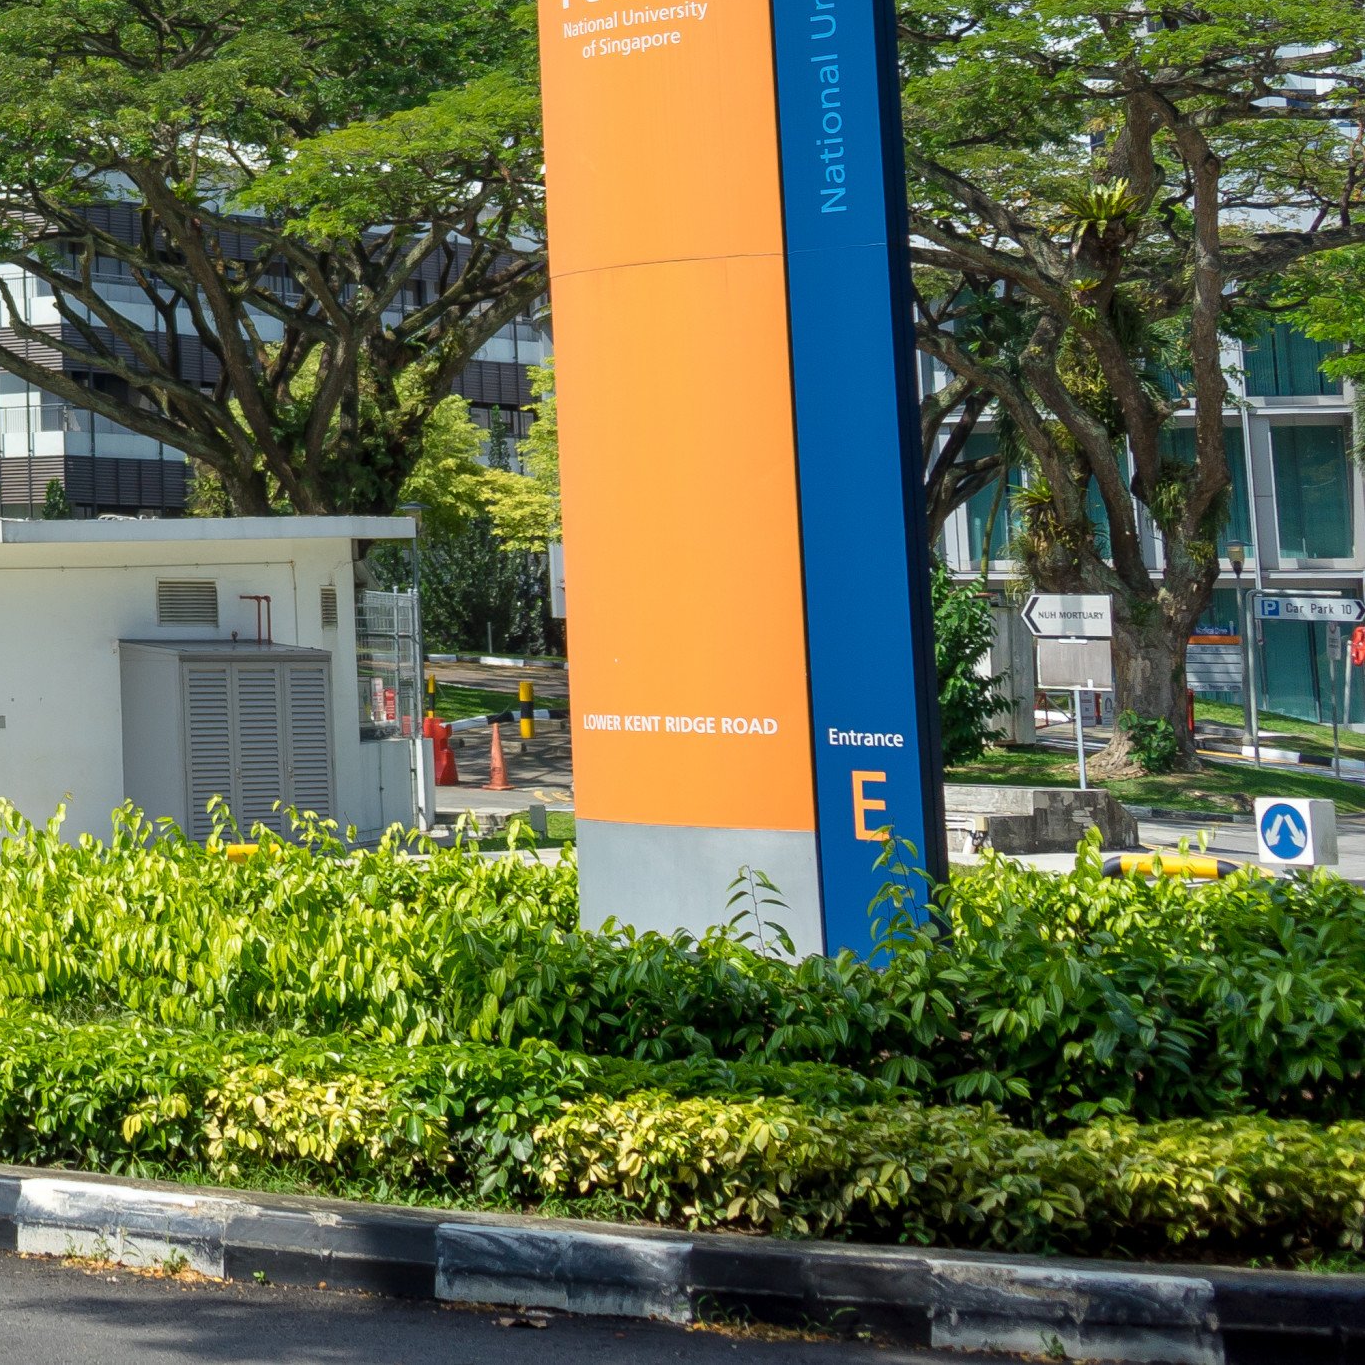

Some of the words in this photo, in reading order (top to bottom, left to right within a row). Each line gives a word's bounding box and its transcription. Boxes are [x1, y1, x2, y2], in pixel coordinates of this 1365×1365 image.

[563, 11, 618, 38] National
[622, 0, 708, 26] University
[582, 39, 597, 58] of
[599, 30, 681, 55] Singapore
[810, 54, 847, 214] National
[1038, 611, 1057, 619] NUH
[1059, 612, 1104, 620] MORTUARY
[1285, 603, 1304, 613] Car
[1310, 604, 1334, 614] Park
[1341, 605, 1352, 615] 10
[583, 714, 621, 731] LOWER
[624, 715, 661, 732] KENT
[665, 716, 716, 733] RIDGE
[721, 717, 779, 735] ROAD
[828, 728, 904, 748] Entrance
[851, 771, 890, 841] E
